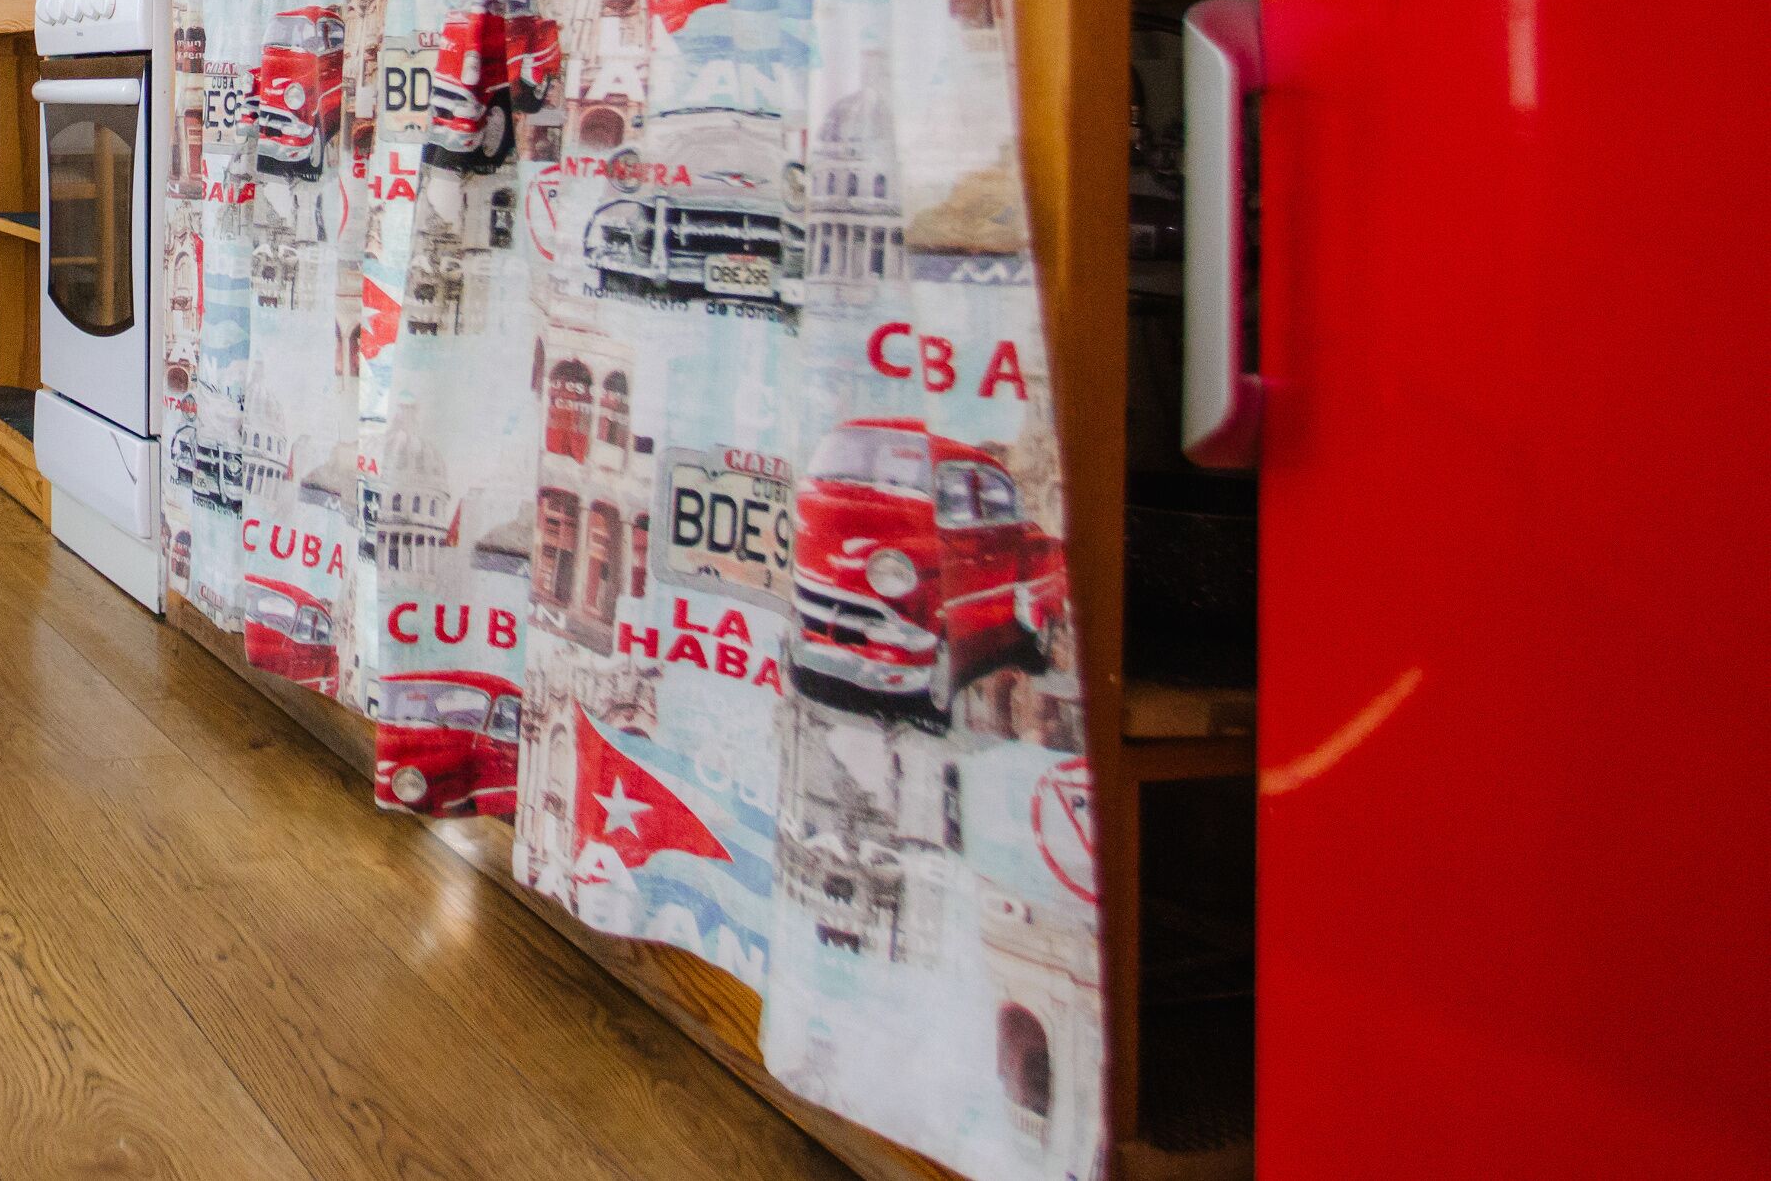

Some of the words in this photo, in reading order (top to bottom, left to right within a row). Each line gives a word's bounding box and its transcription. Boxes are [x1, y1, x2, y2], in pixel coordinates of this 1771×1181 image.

[242, 518, 344, 580] CUBA
[387, 601, 518, 651] CUB
[672, 597, 752, 648] LA
[617, 621, 786, 697] HABA
